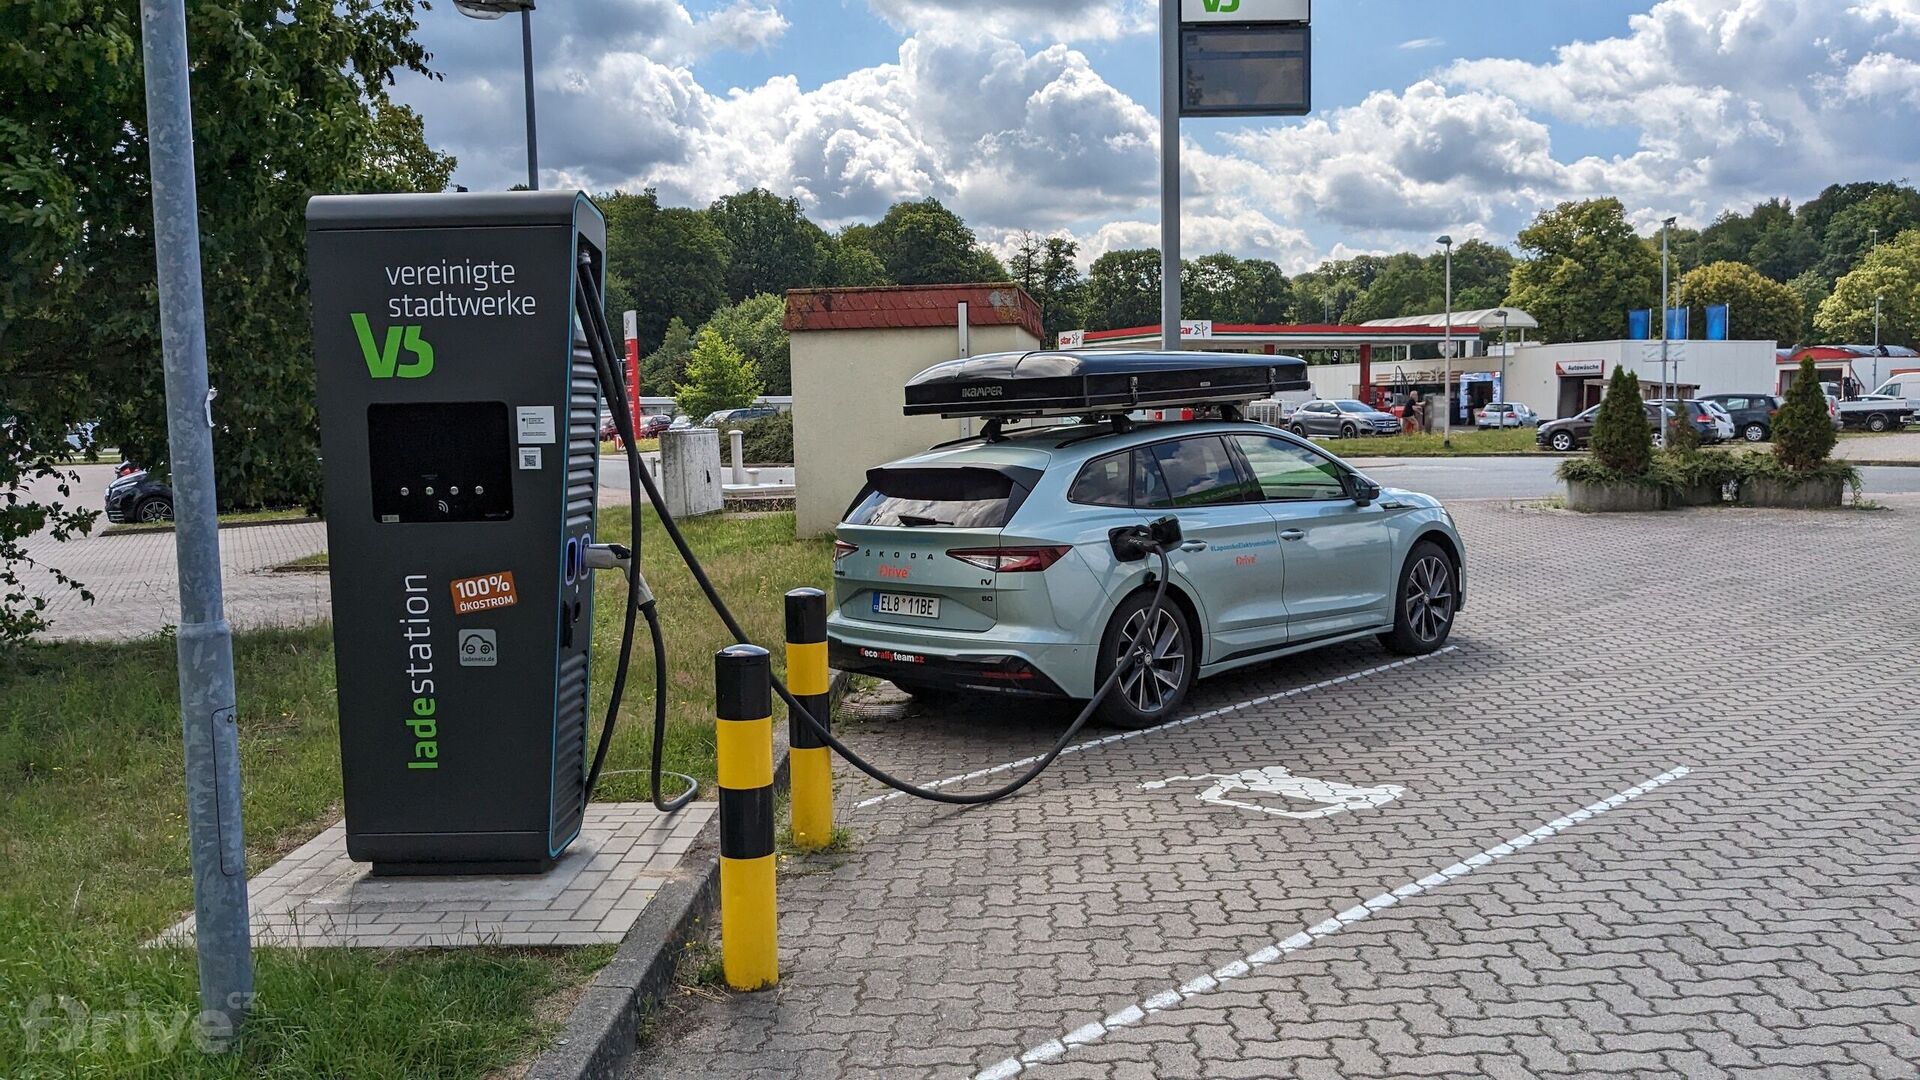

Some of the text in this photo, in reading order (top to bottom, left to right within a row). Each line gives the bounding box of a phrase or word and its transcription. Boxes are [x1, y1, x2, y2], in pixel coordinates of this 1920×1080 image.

[385, 258, 515, 291] vereinigte
[389, 290, 536, 318] stadtwerke
[1567, 363, 1600, 371] Autowäsche
[865, 548, 934, 560] ŠKODA
[456, 575, 511, 599] 100%
[459, 595, 514, 612] ÖKOSTROM
[880, 595, 934, 616] EL8 11BE
[400, 574, 439, 769] ladestation
